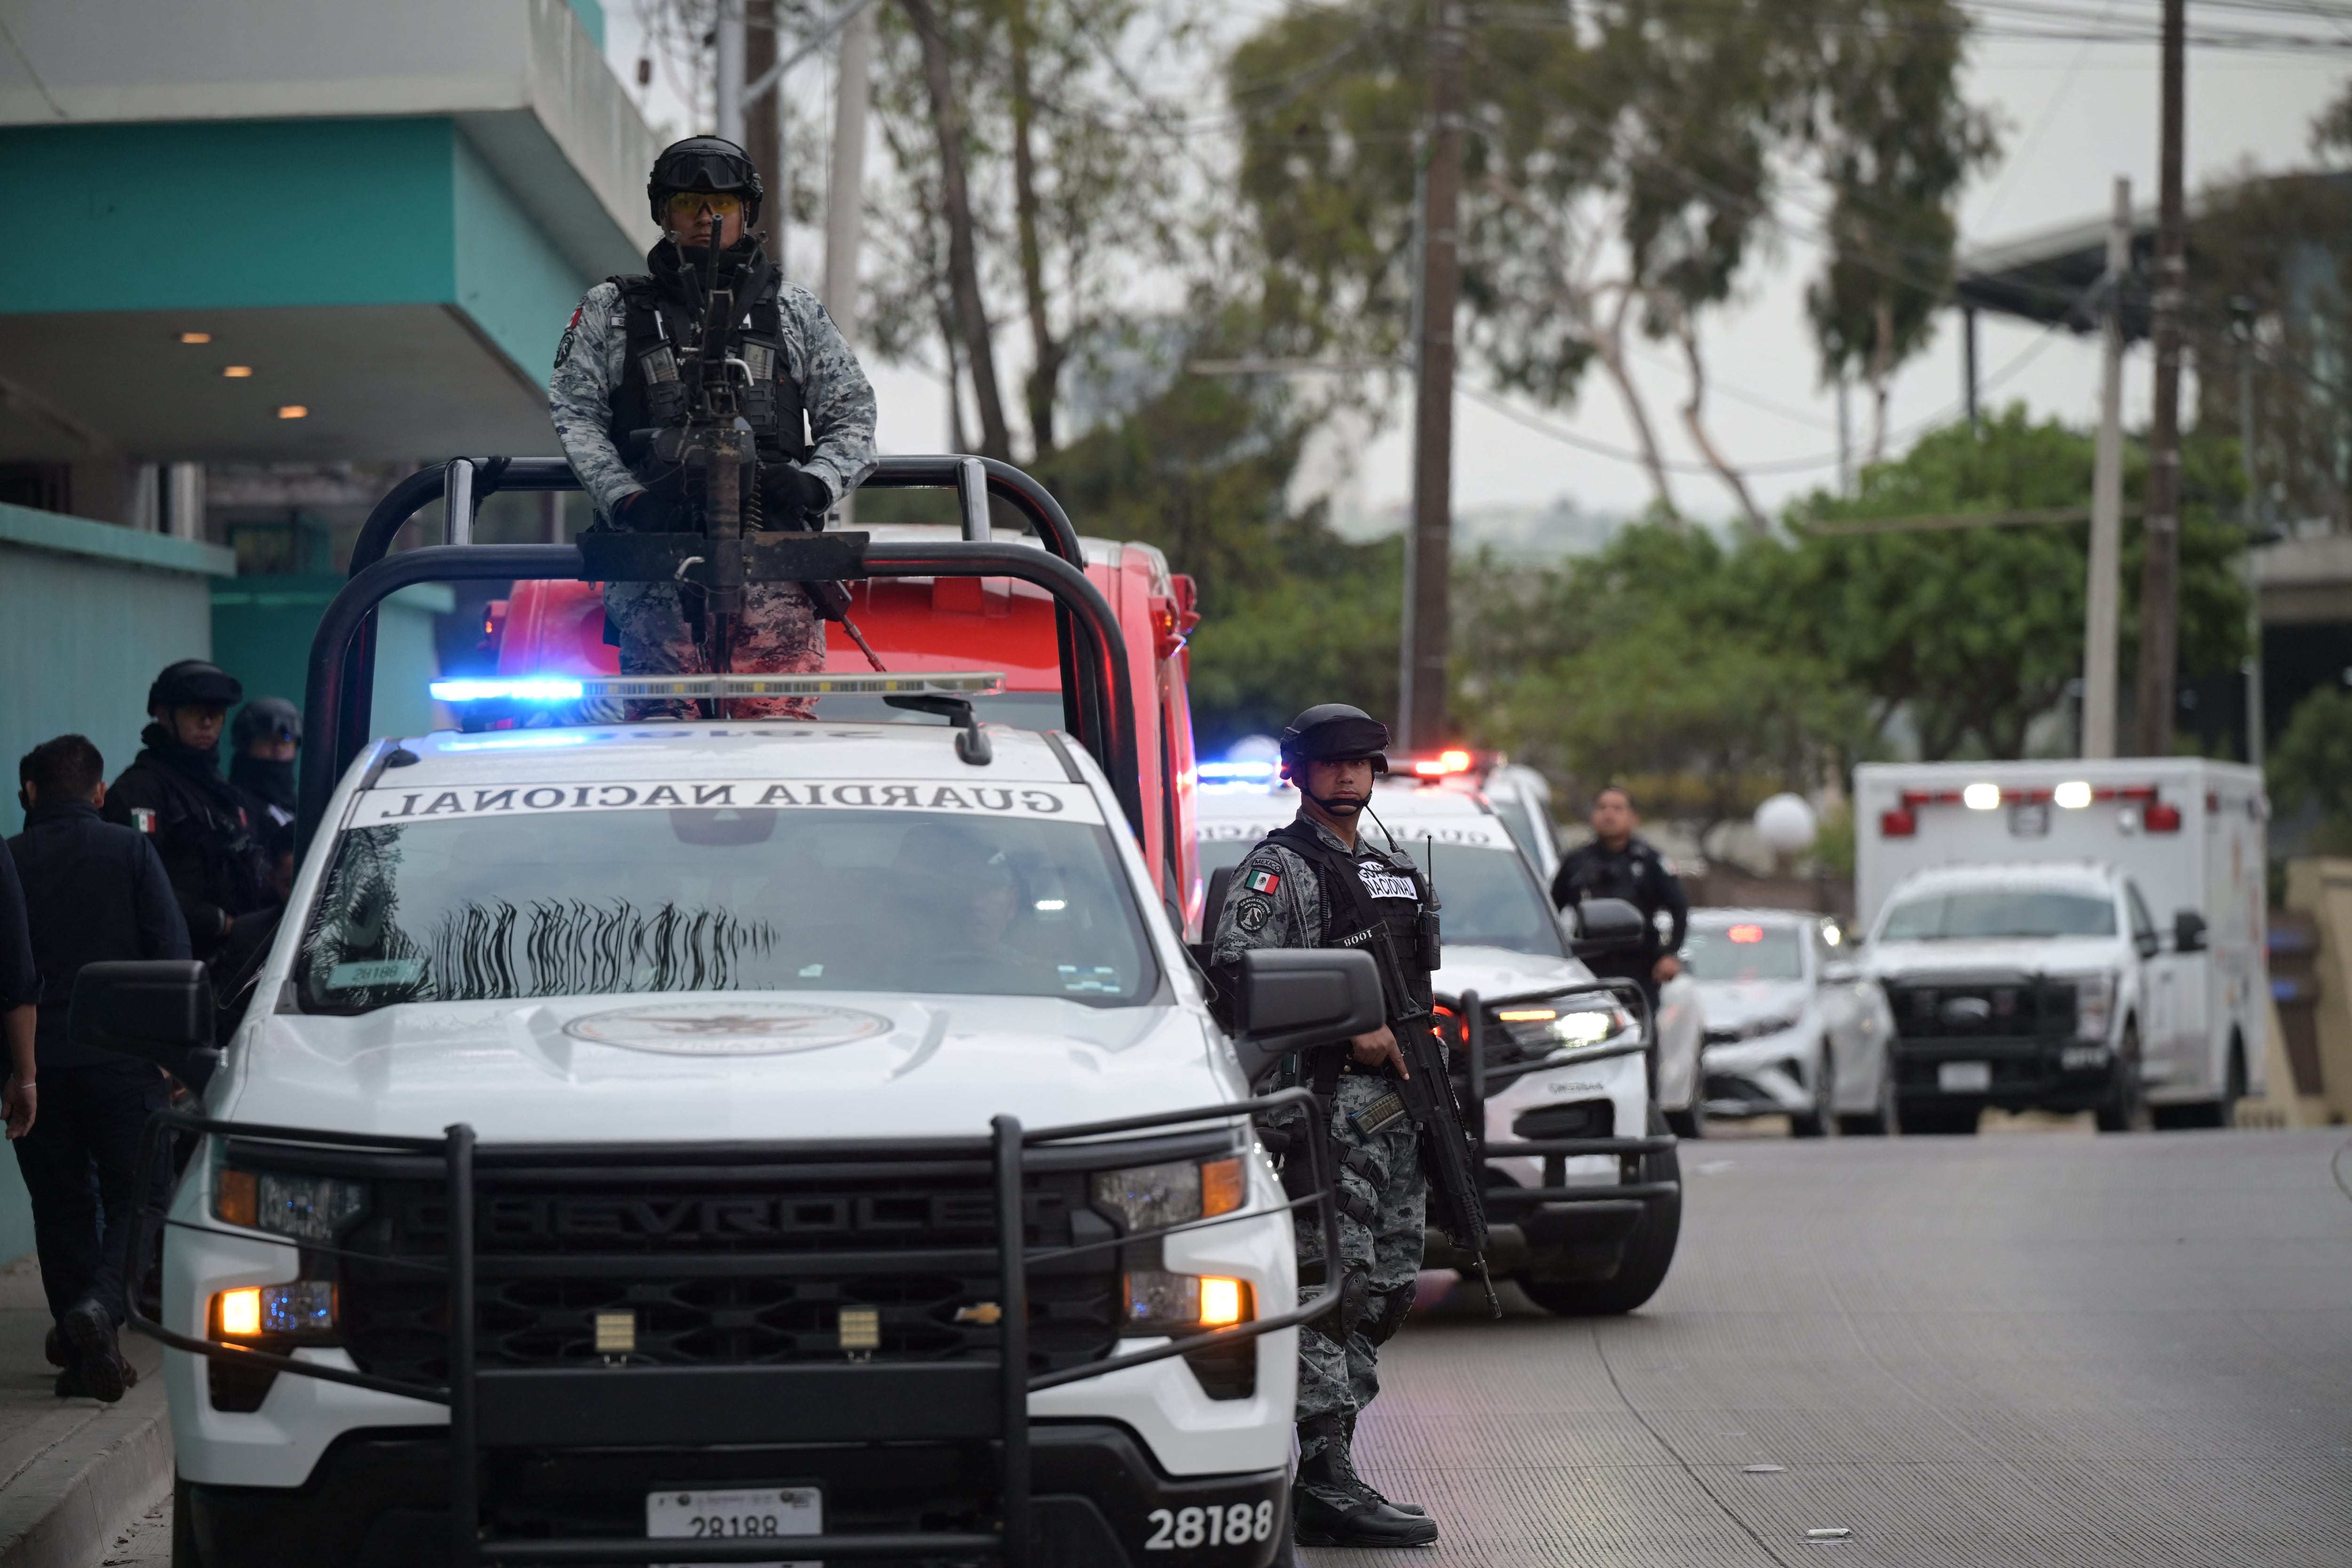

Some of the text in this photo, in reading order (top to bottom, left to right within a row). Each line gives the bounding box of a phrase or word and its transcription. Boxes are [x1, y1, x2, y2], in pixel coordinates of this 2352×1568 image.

[1254, 860, 1281, 871] MEXICO
[1362, 878, 1414, 896] NACIONAL
[1144, 1499, 1274, 1550] 28188
